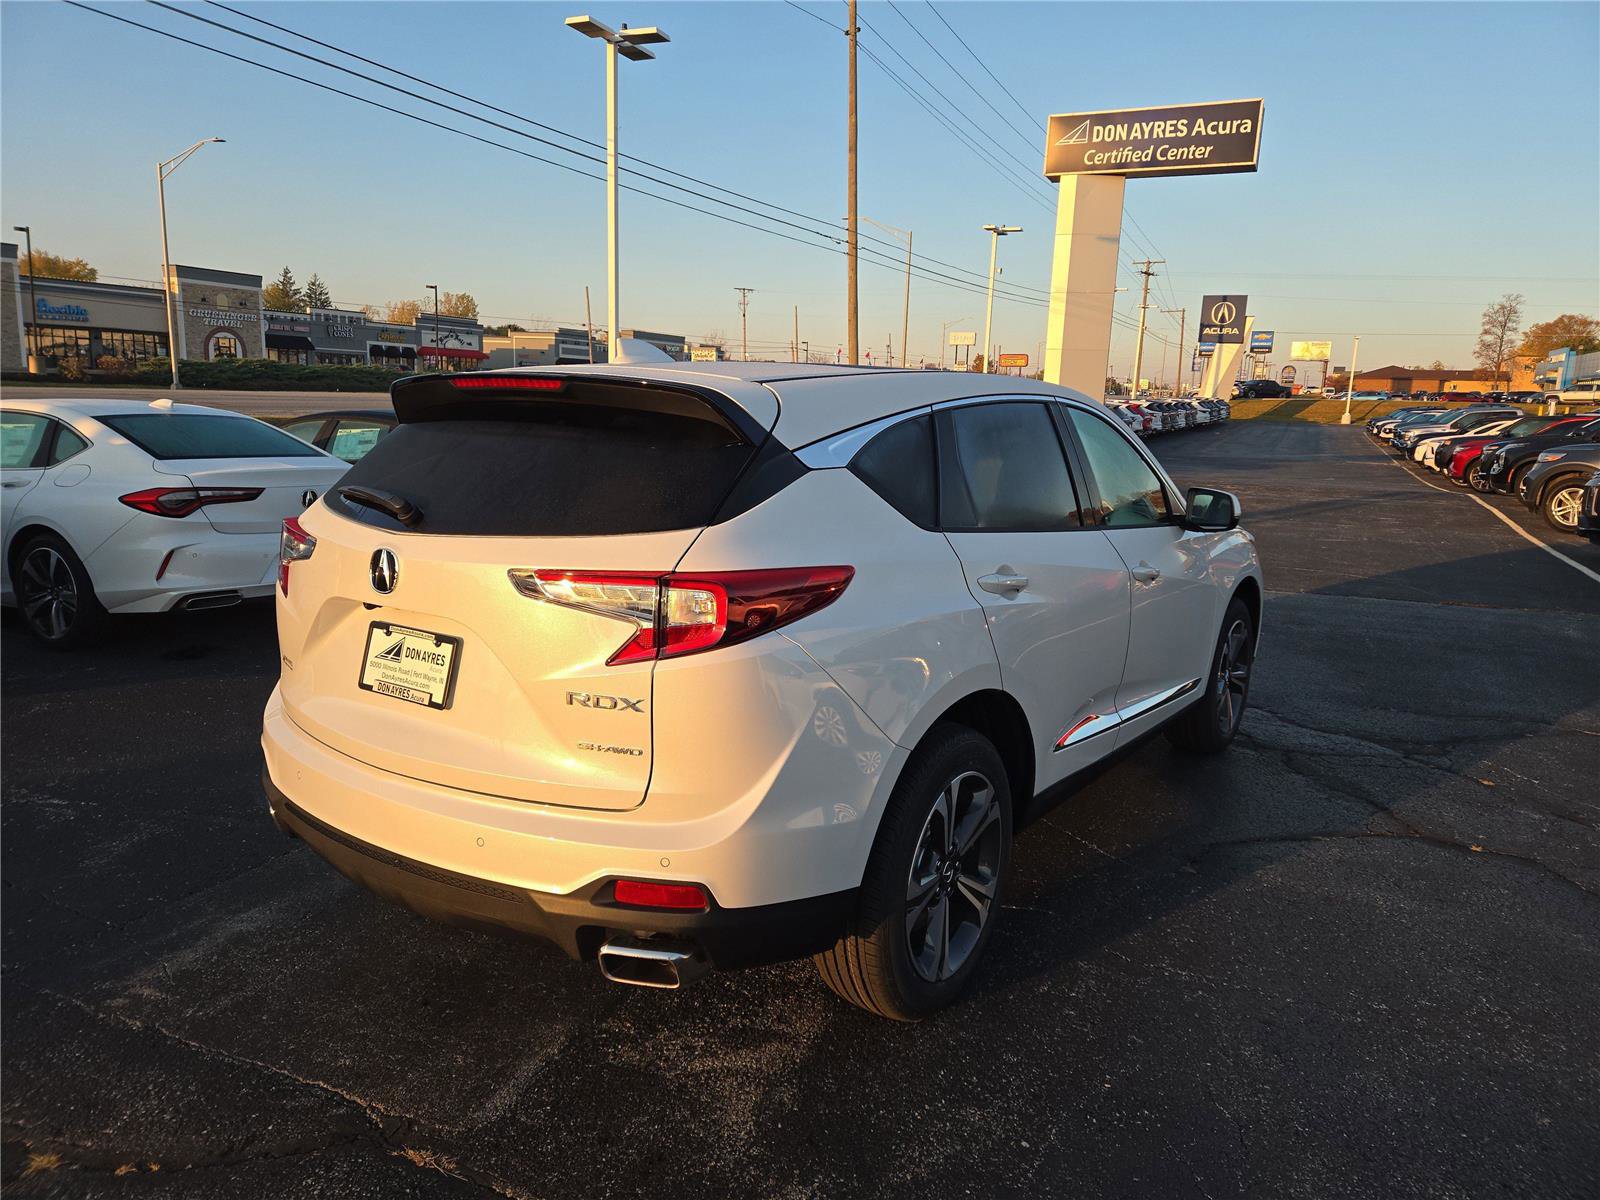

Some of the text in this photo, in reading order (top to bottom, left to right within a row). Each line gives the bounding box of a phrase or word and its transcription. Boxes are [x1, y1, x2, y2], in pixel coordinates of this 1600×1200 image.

[1092, 118, 1252, 143] DON AYRES Acura
[1083, 144, 1213, 165] Certified Center
[189, 308, 257, 322] GRUENINGER
[203, 318, 243, 328] TRAVEL
[1202, 327, 1240, 335] ACURA
[405, 646, 446, 667] DON AYRES
[377, 682, 425, 703] DON AYRES Acura
[566, 691, 646, 713] RDX
[577, 742, 643, 756] SH-AWD
